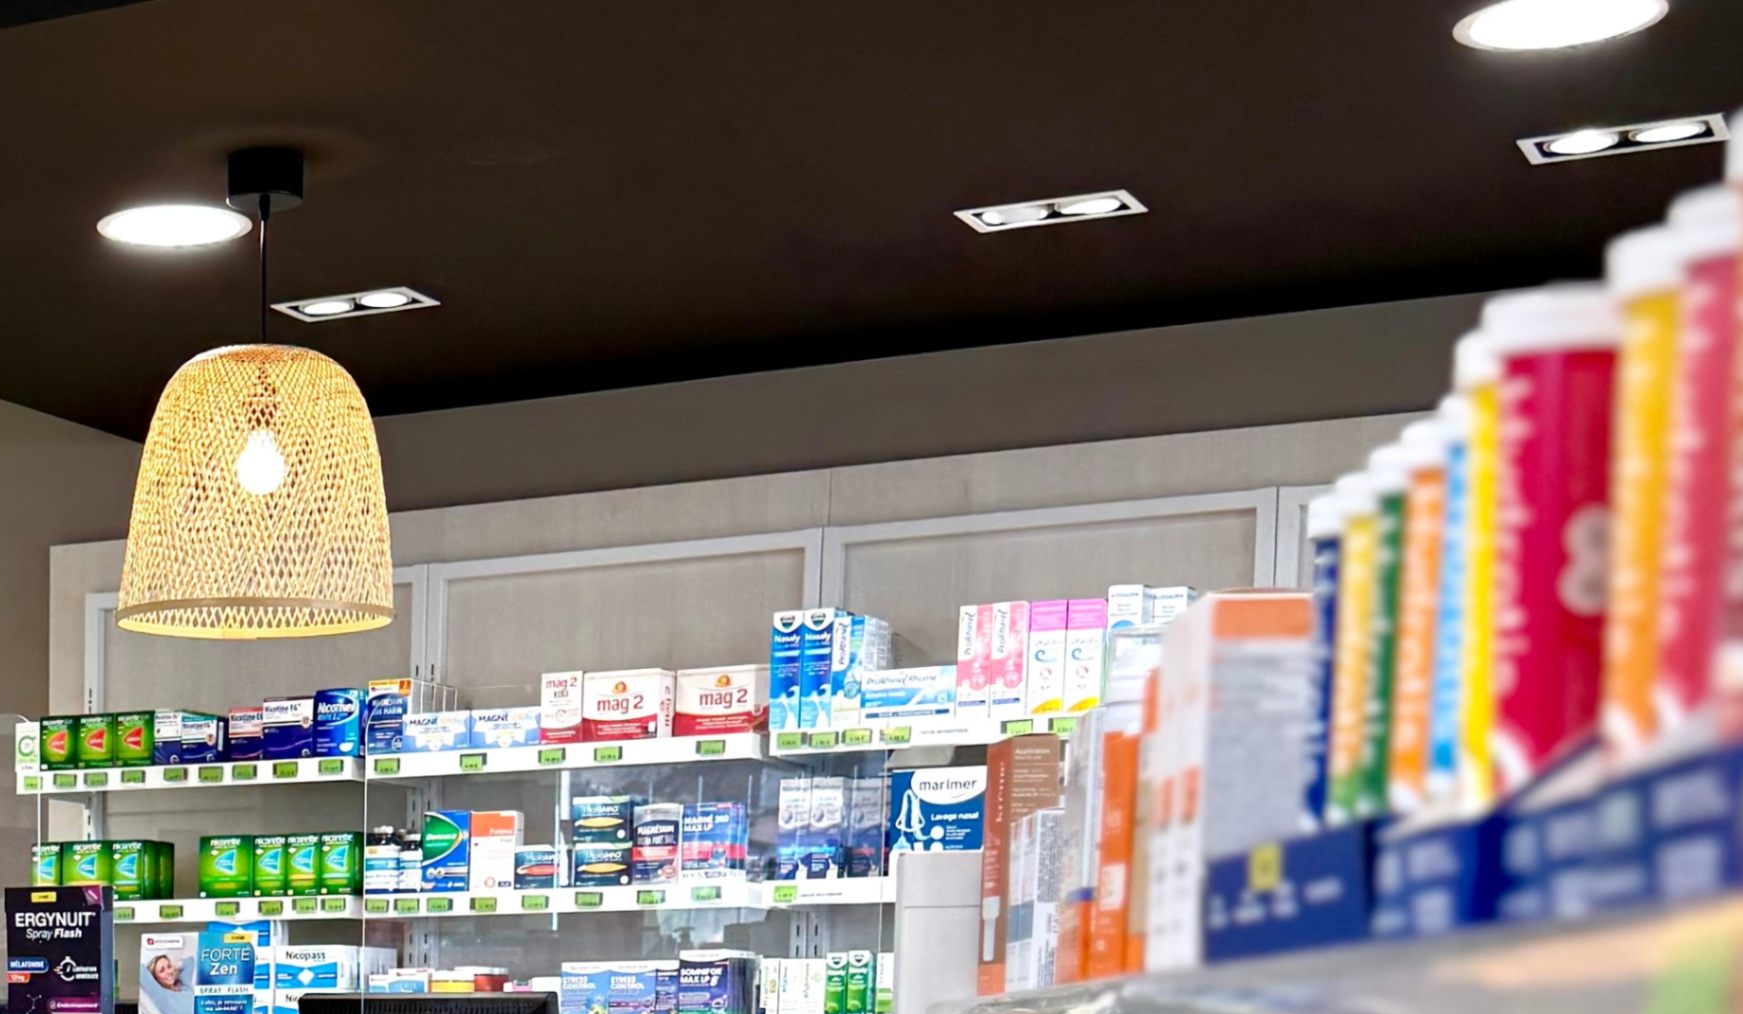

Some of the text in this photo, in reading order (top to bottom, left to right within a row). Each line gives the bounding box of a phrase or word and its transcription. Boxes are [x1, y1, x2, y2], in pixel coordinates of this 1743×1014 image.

[546, 677, 577, 689] mag 2
[596, 695, 644, 714] mag 2
[699, 688, 748, 709] mag 2
[919, 777, 977, 791] marimer
[931, 811, 979, 822] Lavage nasal
[14, 911, 94, 928] ERGYNUIT
[25, 927, 83, 941] Spray Flash
[285, 951, 326, 962] Nicopass
[209, 963, 239, 977] Zen
